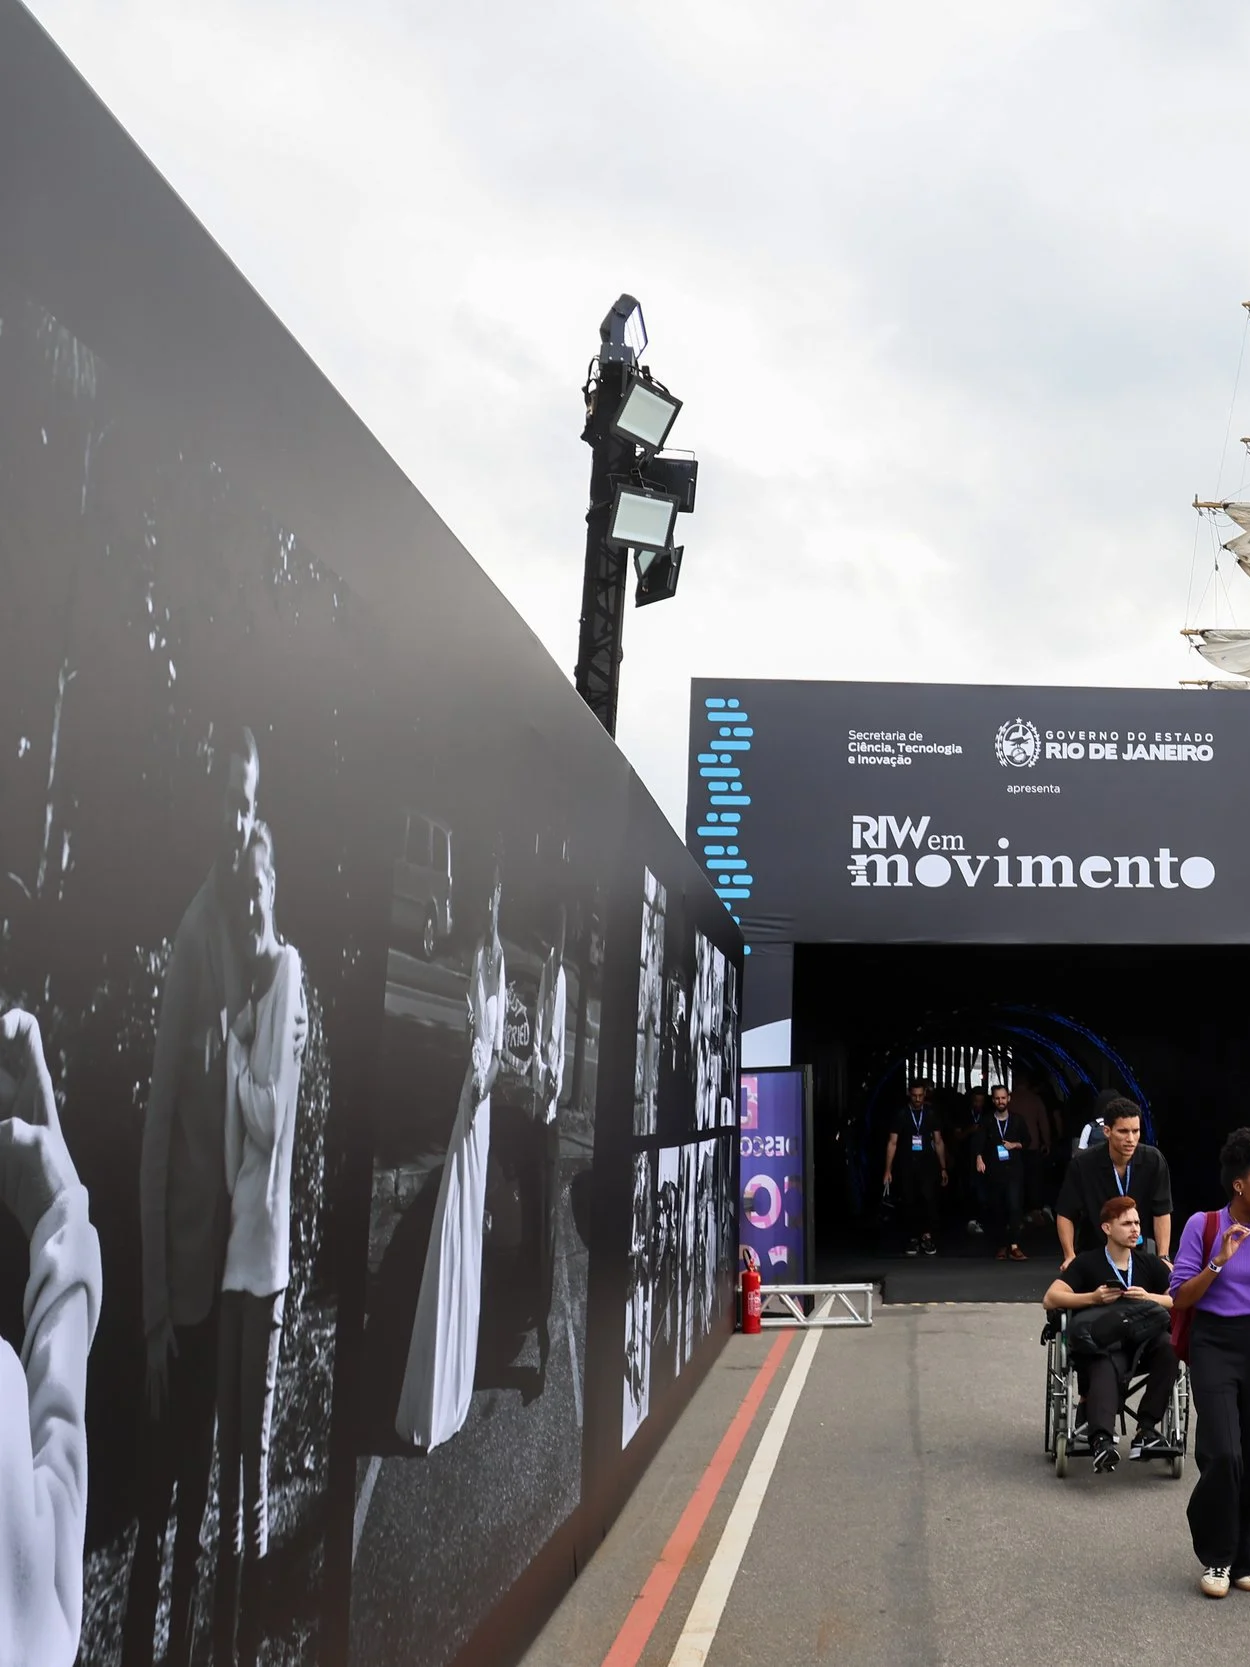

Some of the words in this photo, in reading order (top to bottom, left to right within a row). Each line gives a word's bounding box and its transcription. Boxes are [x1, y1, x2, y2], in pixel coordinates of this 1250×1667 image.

[848, 730, 906, 741] Secretaria
[908, 731, 923, 741] de
[1045, 730, 1119, 741] GOVERNO
[1127, 732, 1147, 742] DO
[1155, 732, 1214, 743] ESTADO
[848, 742, 895, 754] Ciência,
[896, 743, 963, 756] Tecnologia
[1045, 742, 1085, 760] RIO
[1088, 743, 1118, 760] DE
[1122, 743, 1214, 762] JANEIRO
[848, 756, 856, 765] e
[857, 754, 912, 767] Inovação
[1006, 784, 1061, 795] apresenta
[852, 815, 931, 849] RIW
[927, 834, 965, 850] em
[847, 837, 1215, 888] movimento
